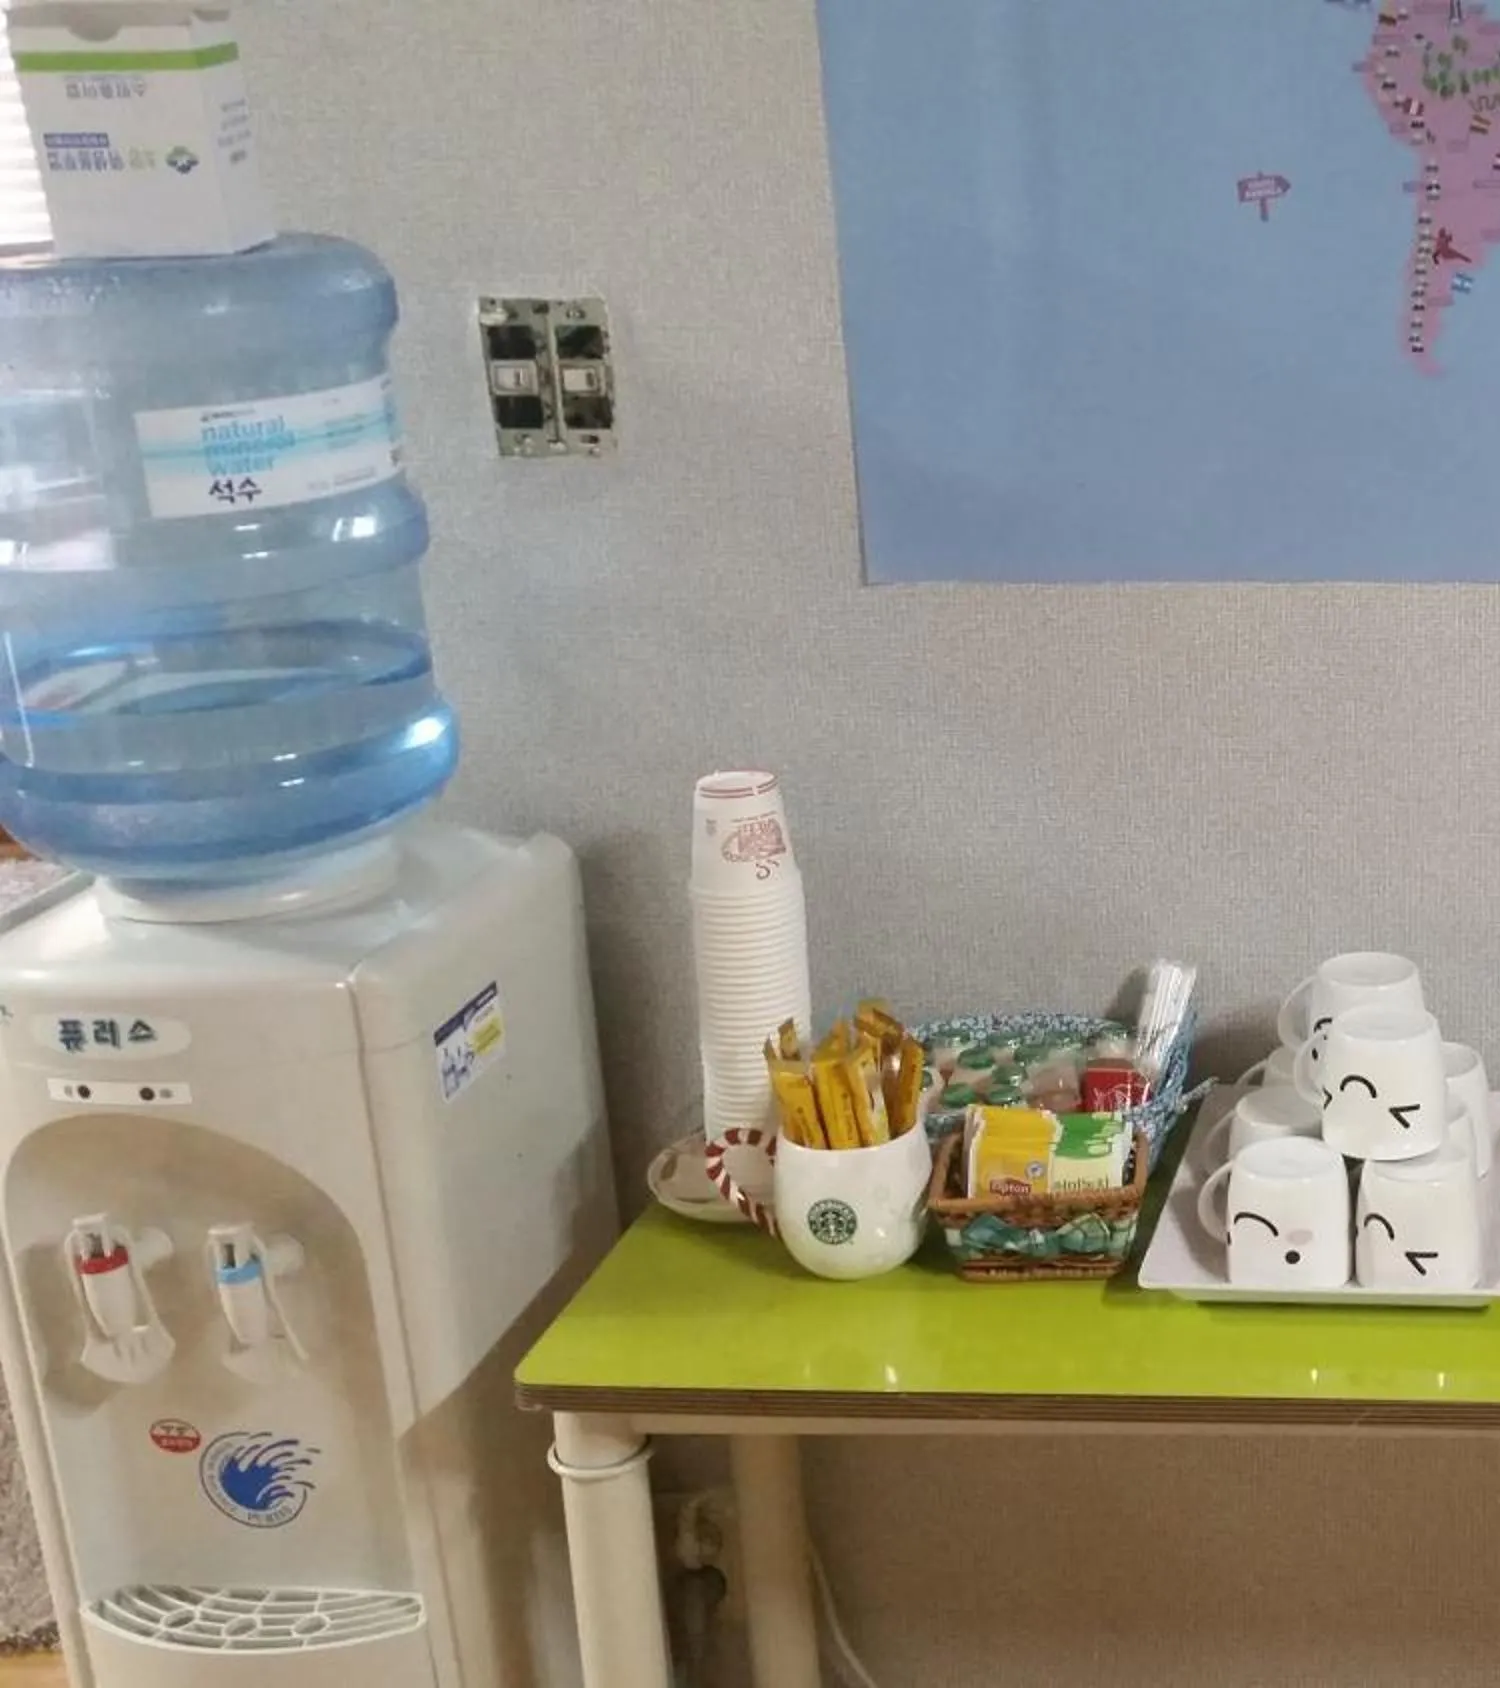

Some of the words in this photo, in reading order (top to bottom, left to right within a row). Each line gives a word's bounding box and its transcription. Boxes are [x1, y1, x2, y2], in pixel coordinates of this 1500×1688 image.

[202, 414, 286, 442] natural
[205, 455, 274, 477] water
[208, 477, 262, 504] 석수
